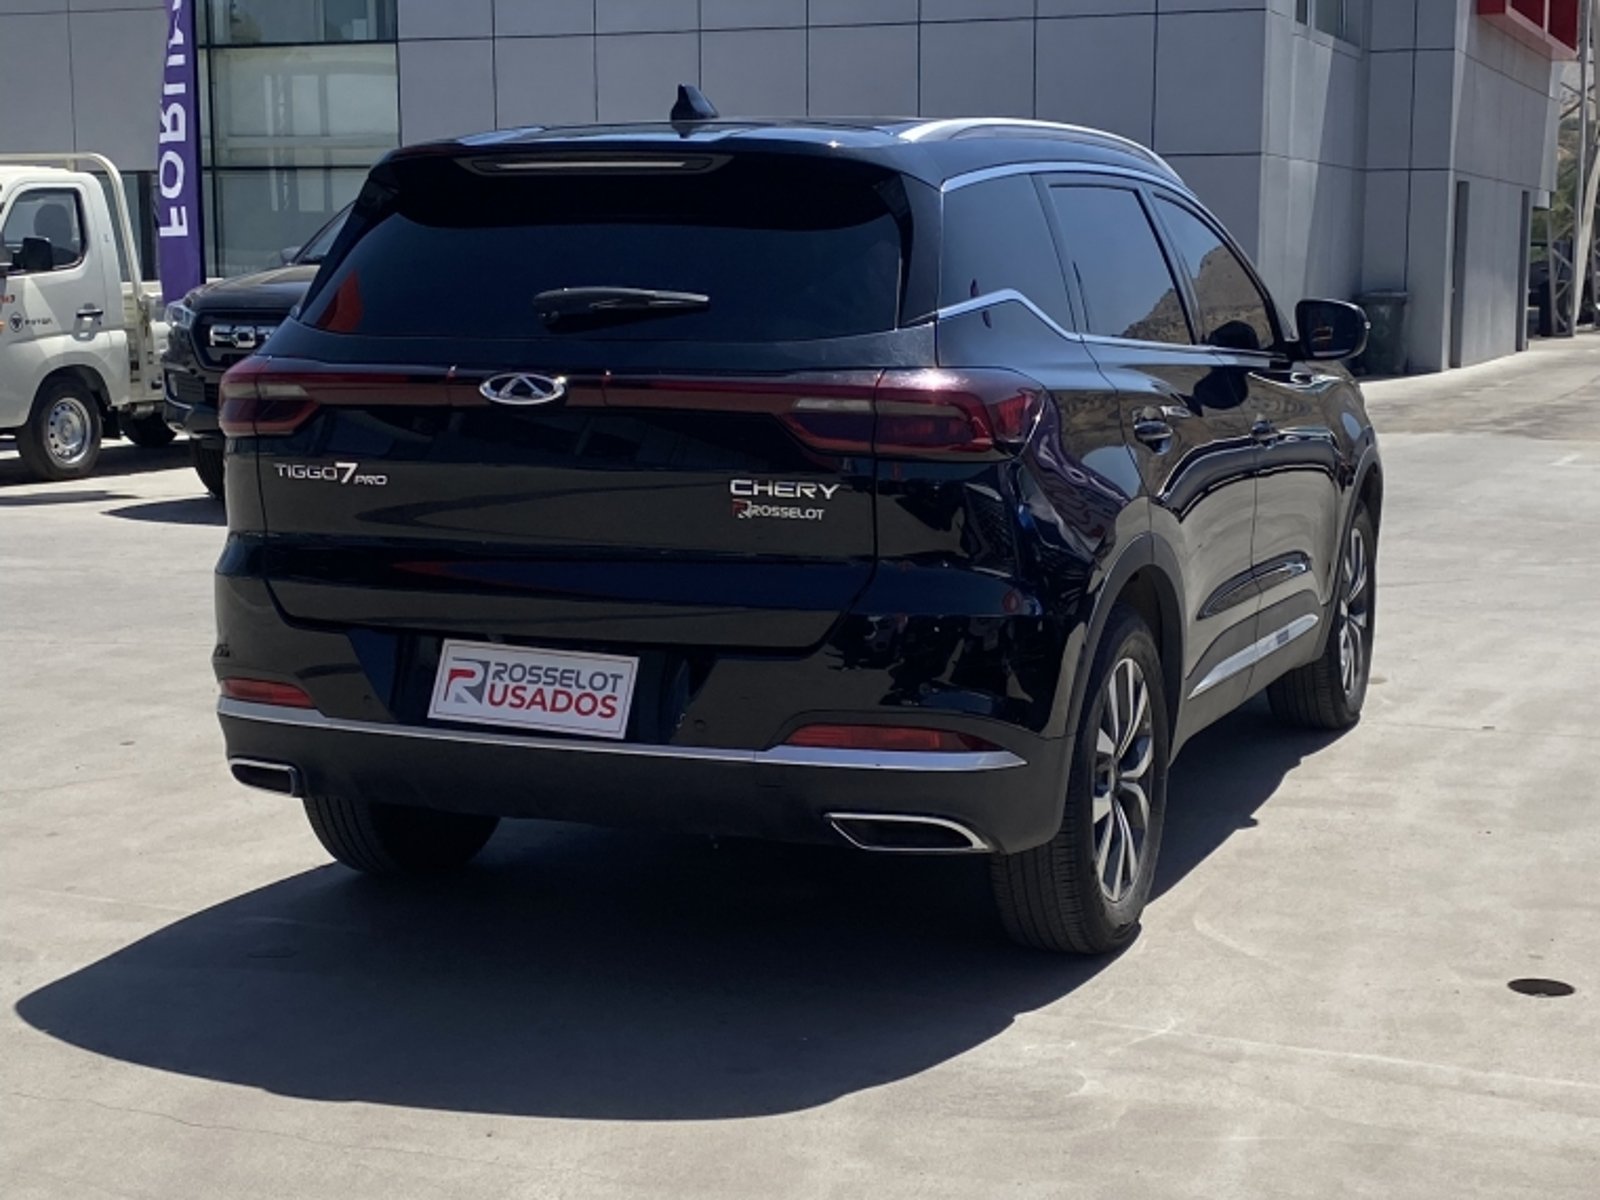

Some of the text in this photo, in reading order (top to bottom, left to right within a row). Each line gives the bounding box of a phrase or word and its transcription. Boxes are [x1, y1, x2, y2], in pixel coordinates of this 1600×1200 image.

[274, 462, 387, 485] TIGGO 7 PRO
[730, 479, 840, 499] CHERY
[751, 505, 824, 519] ROSSELOT
[492, 662, 624, 693] ROSSELOT
[487, 683, 618, 719] USADOS
